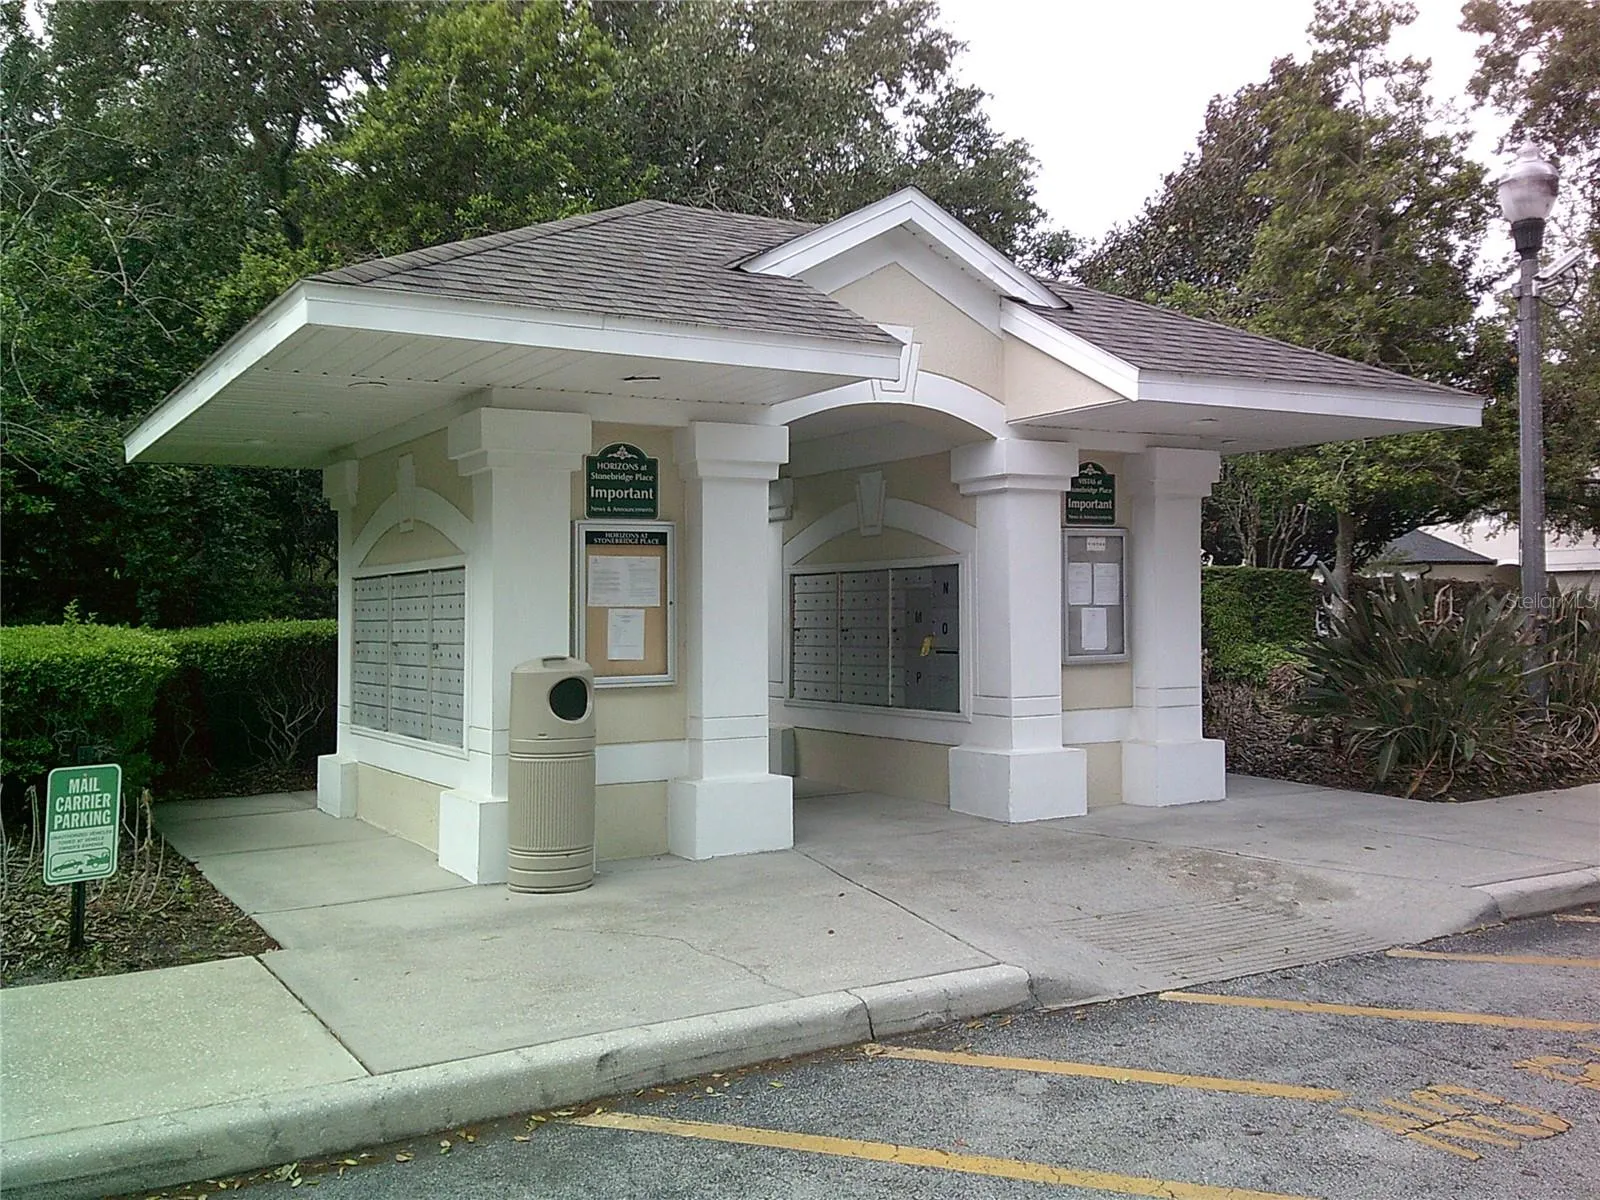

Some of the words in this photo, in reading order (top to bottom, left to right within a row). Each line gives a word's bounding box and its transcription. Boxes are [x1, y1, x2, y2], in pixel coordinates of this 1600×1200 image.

[597, 462, 639, 471] HORIZONS
[591, 472, 634, 482] Stonebridge
[635, 473, 654, 481] Place
[590, 486, 654, 502] Important
[1071, 486, 1097, 494] tonebridge
[1068, 498, 1113, 512] Important
[943, 580, 949, 594] N
[915, 609, 923, 623] M
[916, 671, 922, 684] P
[69, 777, 101, 794] MAIL
[55, 793, 111, 812] CARRIER
[54, 809, 111, 830] PARKING
